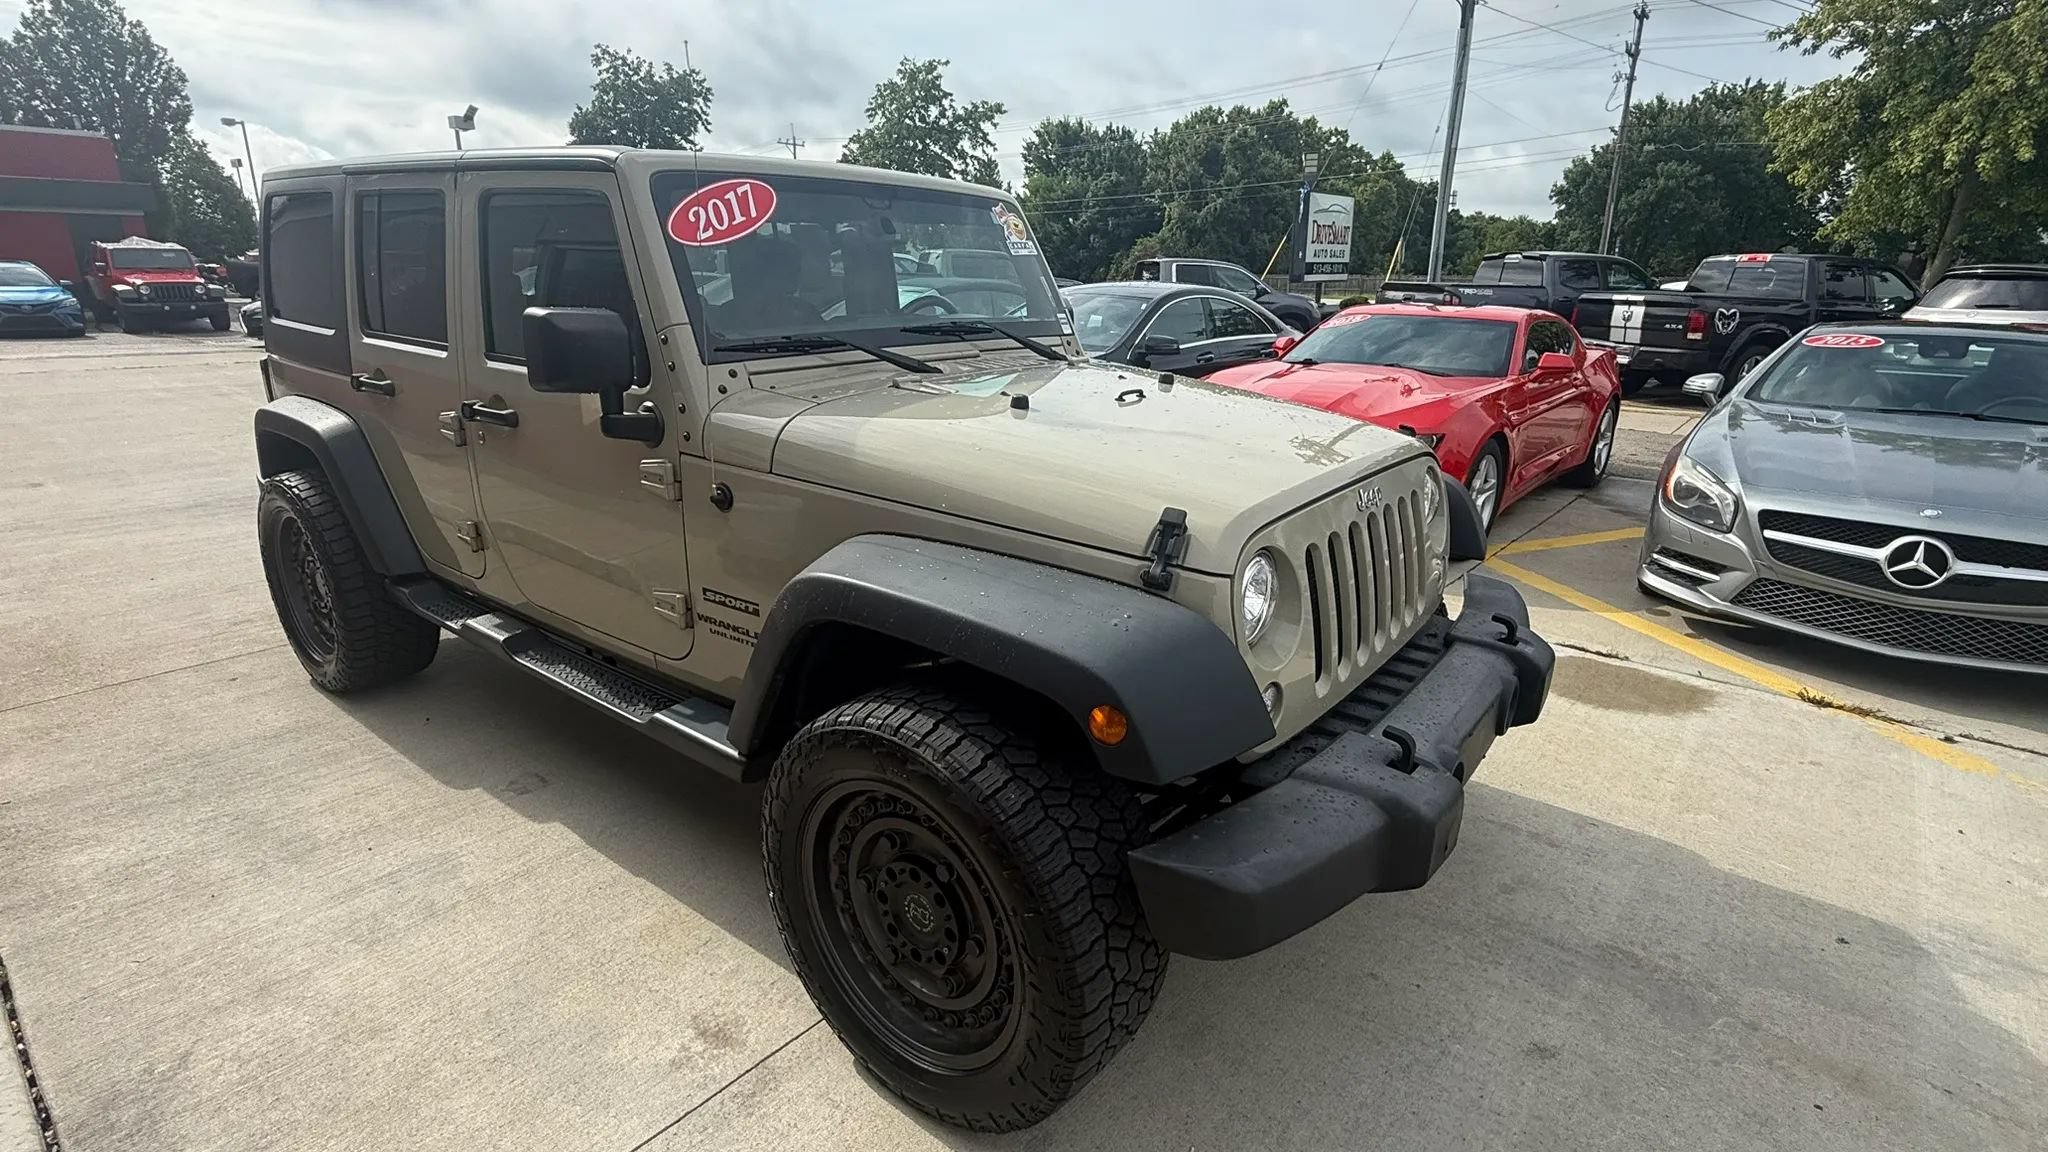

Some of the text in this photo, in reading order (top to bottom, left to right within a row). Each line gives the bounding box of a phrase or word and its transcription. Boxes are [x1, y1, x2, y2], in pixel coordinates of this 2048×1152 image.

[688, 183, 757, 241] 2017
[1313, 249, 1345, 259] AUTO SALES
[704, 590, 758, 614] SPORT
